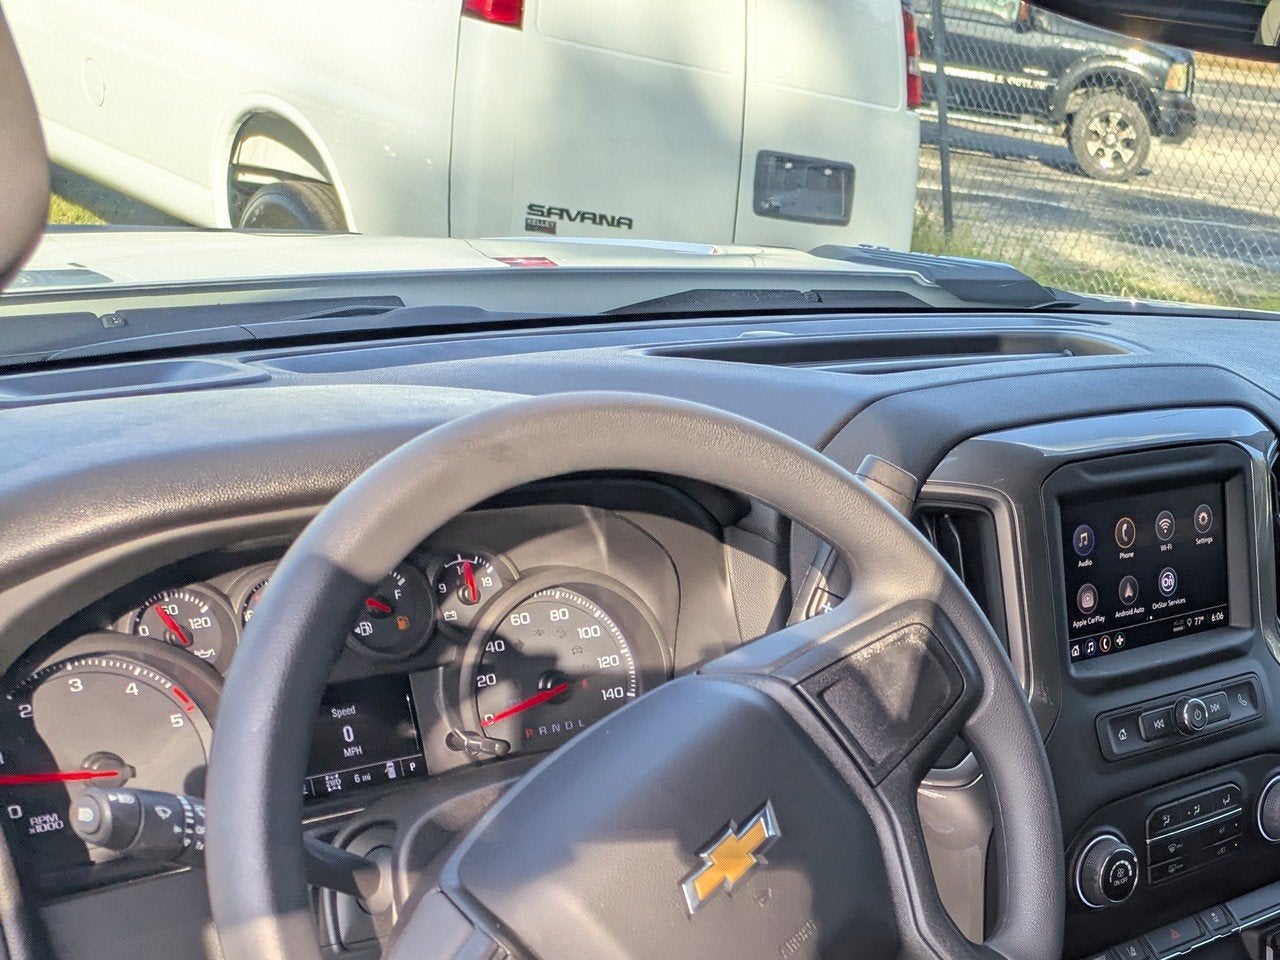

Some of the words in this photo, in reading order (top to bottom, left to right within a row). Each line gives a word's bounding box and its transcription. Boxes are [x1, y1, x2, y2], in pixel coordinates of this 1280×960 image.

[527, 203, 633, 230] SAVANA
[1195, 537, 1213, 545] Settings
[1119, 551, 1134, 560] Phone
[438, 583, 447, 594] 9
[481, 576, 493, 588] 19
[394, 589, 402, 600] F
[1152, 600, 1167, 610] OnStar
[1168, 597, 1186, 607] Services
[510, 612, 531, 626] 60
[550, 608, 569, 622] 80
[1115, 607, 1133, 618] Android
[1134, 606, 1145, 615] Auto
[1210, 612, 1225, 622] 6:06
[188, 617, 211, 629] 120
[1072, 618, 1087, 628] Apple
[1087, 616, 1106, 626] CarPlay
[138, 626, 149, 637] 0
[577, 625, 601, 640] 100
[485, 640, 506, 653] 40
[597, 654, 620, 669] 120
[69, 678, 83, 692] 3
[477, 674, 497, 688] 20
[125, 682, 139, 696] 4
[601, 686, 624, 701] 140
[18, 704, 33, 718] 2
[331, 705, 356, 718] Speed
[170, 714, 184, 728] 5
[342, 726, 354, 743] 0
[525, 728, 533, 739] P
[539, 726, 548, 736] R
[552, 723, 560, 733] N
[565, 720, 573, 730] D
[343, 746, 362, 758] MPH
[354, 774, 361, 783] 6
[362, 773, 372, 782] mi
[410, 762, 416, 771] P
[7, 805, 22, 819] 0
[30, 813, 58, 826] RPM
[29, 820, 64, 834] x1000
